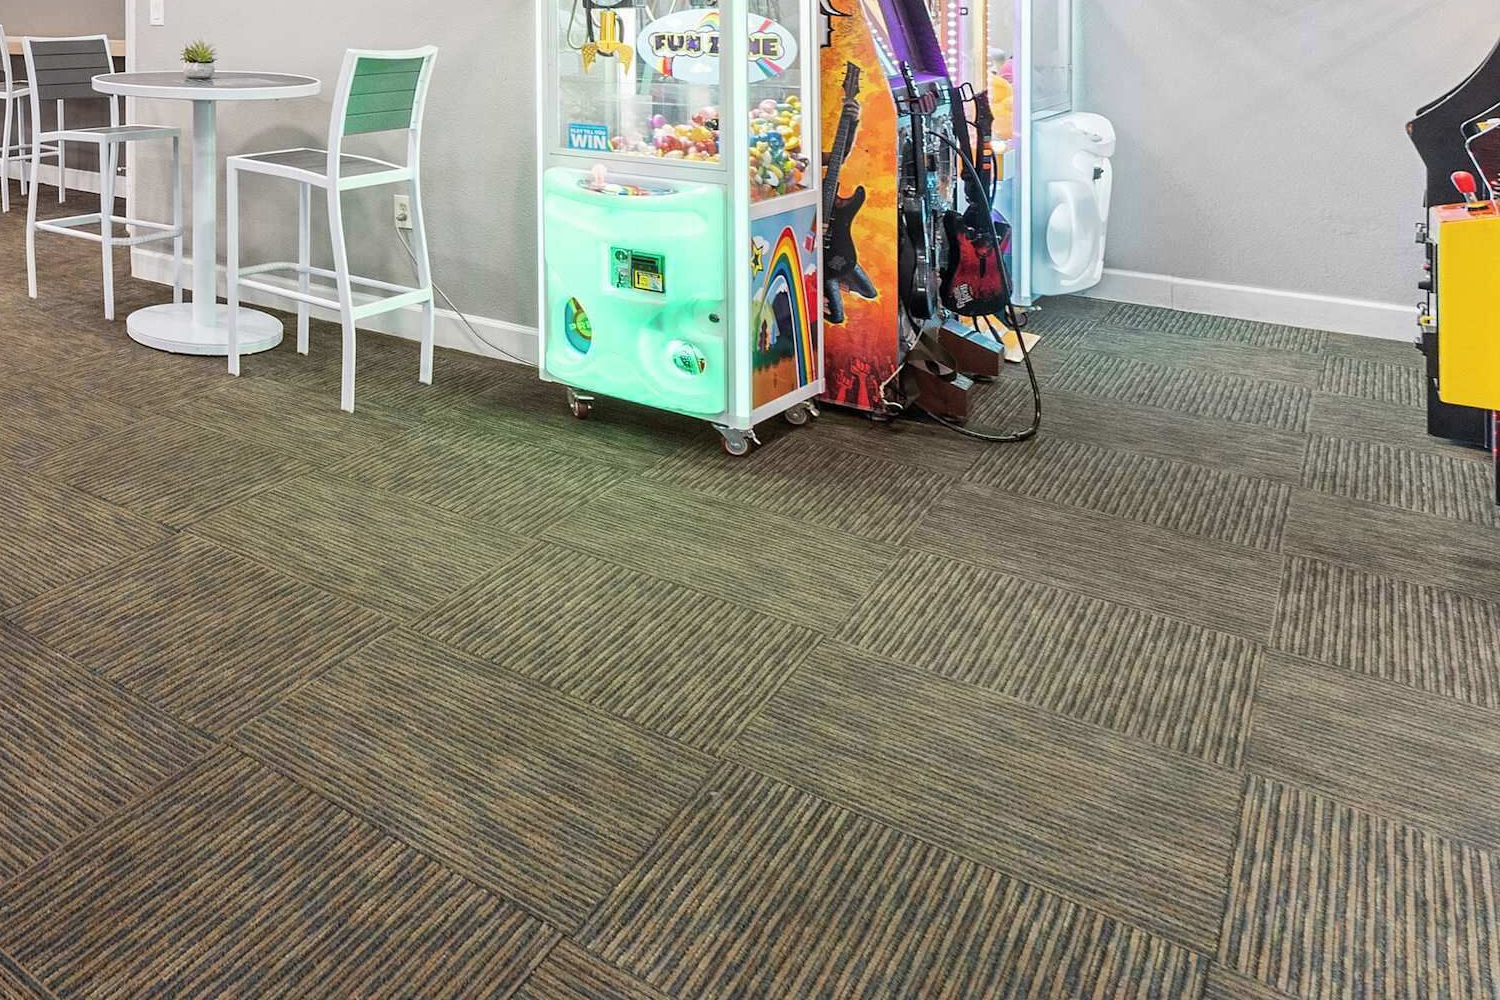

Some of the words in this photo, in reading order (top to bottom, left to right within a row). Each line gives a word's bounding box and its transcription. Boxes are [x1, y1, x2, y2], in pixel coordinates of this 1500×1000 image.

[654, 34, 701, 53] FUN
[708, 36, 779, 56] ZNE
[571, 134, 606, 150] WIN
